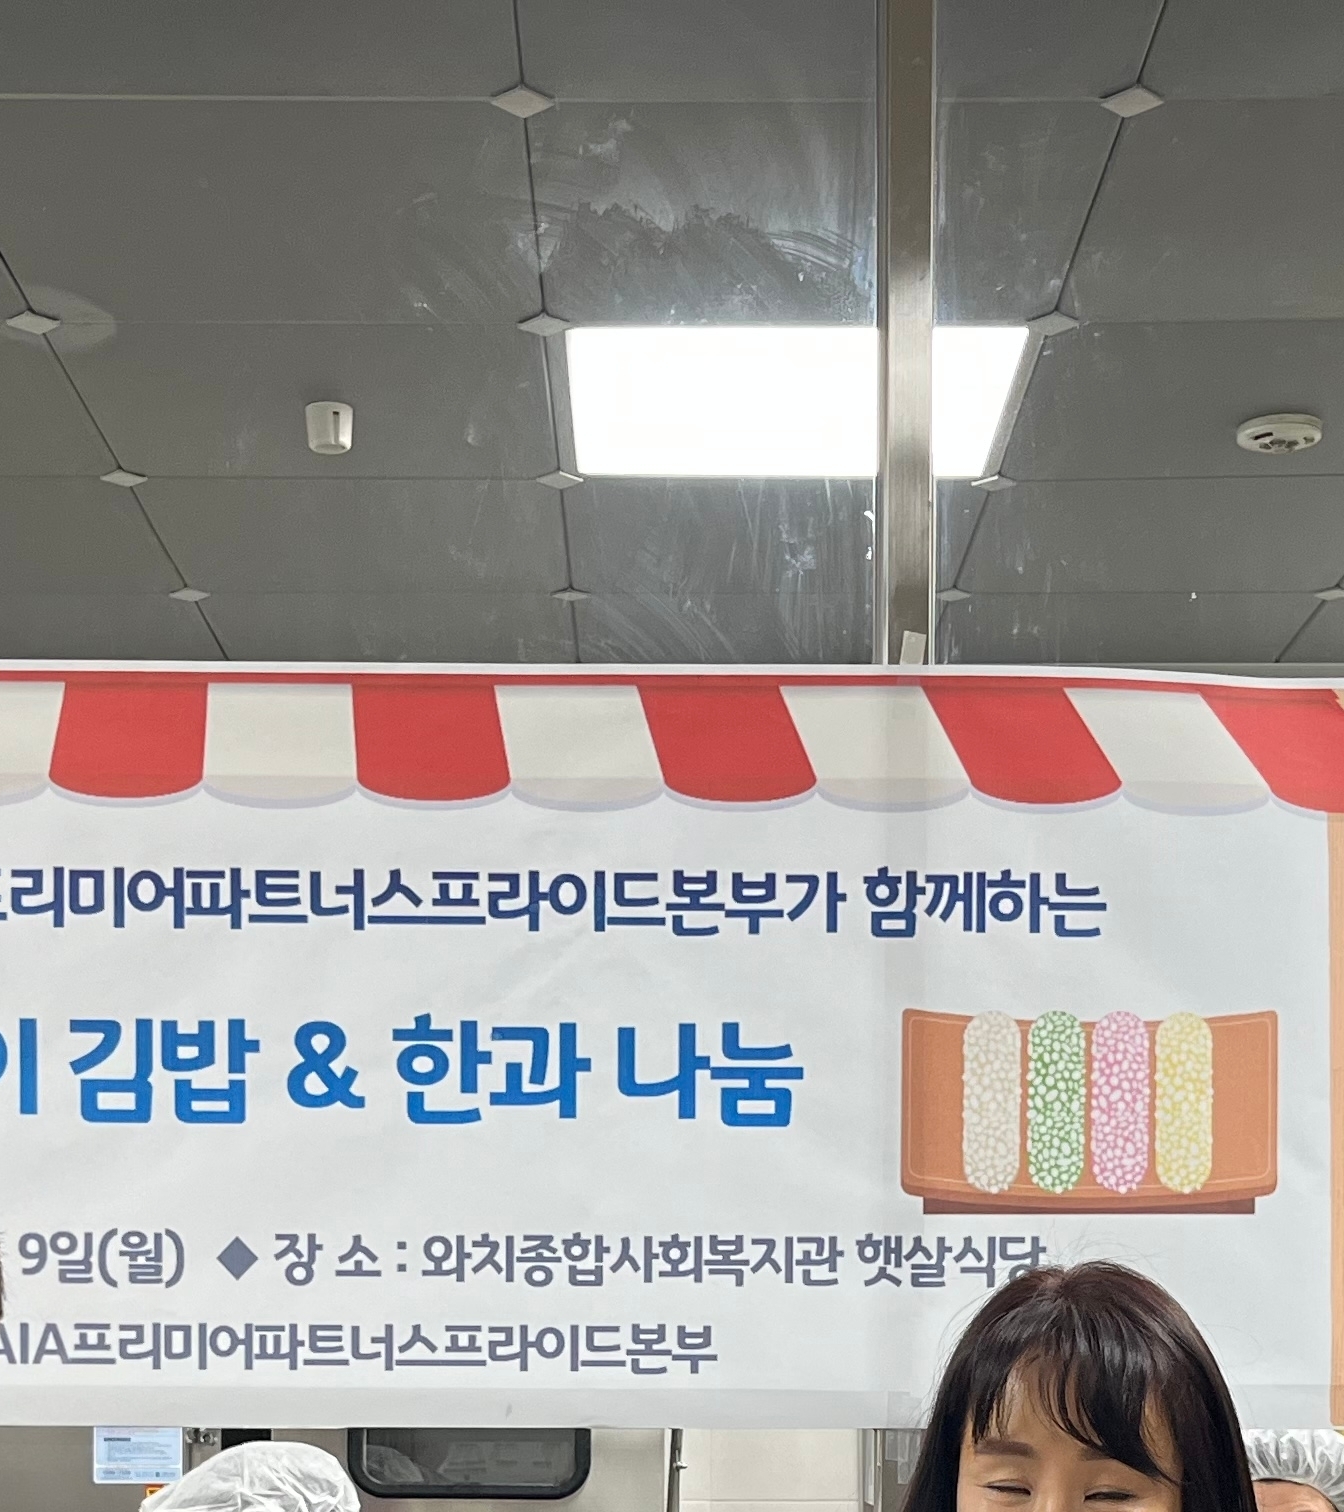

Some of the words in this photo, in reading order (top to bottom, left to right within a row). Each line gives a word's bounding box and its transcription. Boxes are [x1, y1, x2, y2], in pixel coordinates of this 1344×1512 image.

[862, 867, 1107, 938] 함께하는
[69, 1018, 261, 1124] 김밥
[286, 1019, 365, 1108] &
[392, 1013, 591, 1125] 한과
[616, 1019, 804, 1126] 나눔
[421, 1232, 845, 1288] 와치종합사회복지관
[855, 1234, 1047, 1288] 햇살식당
